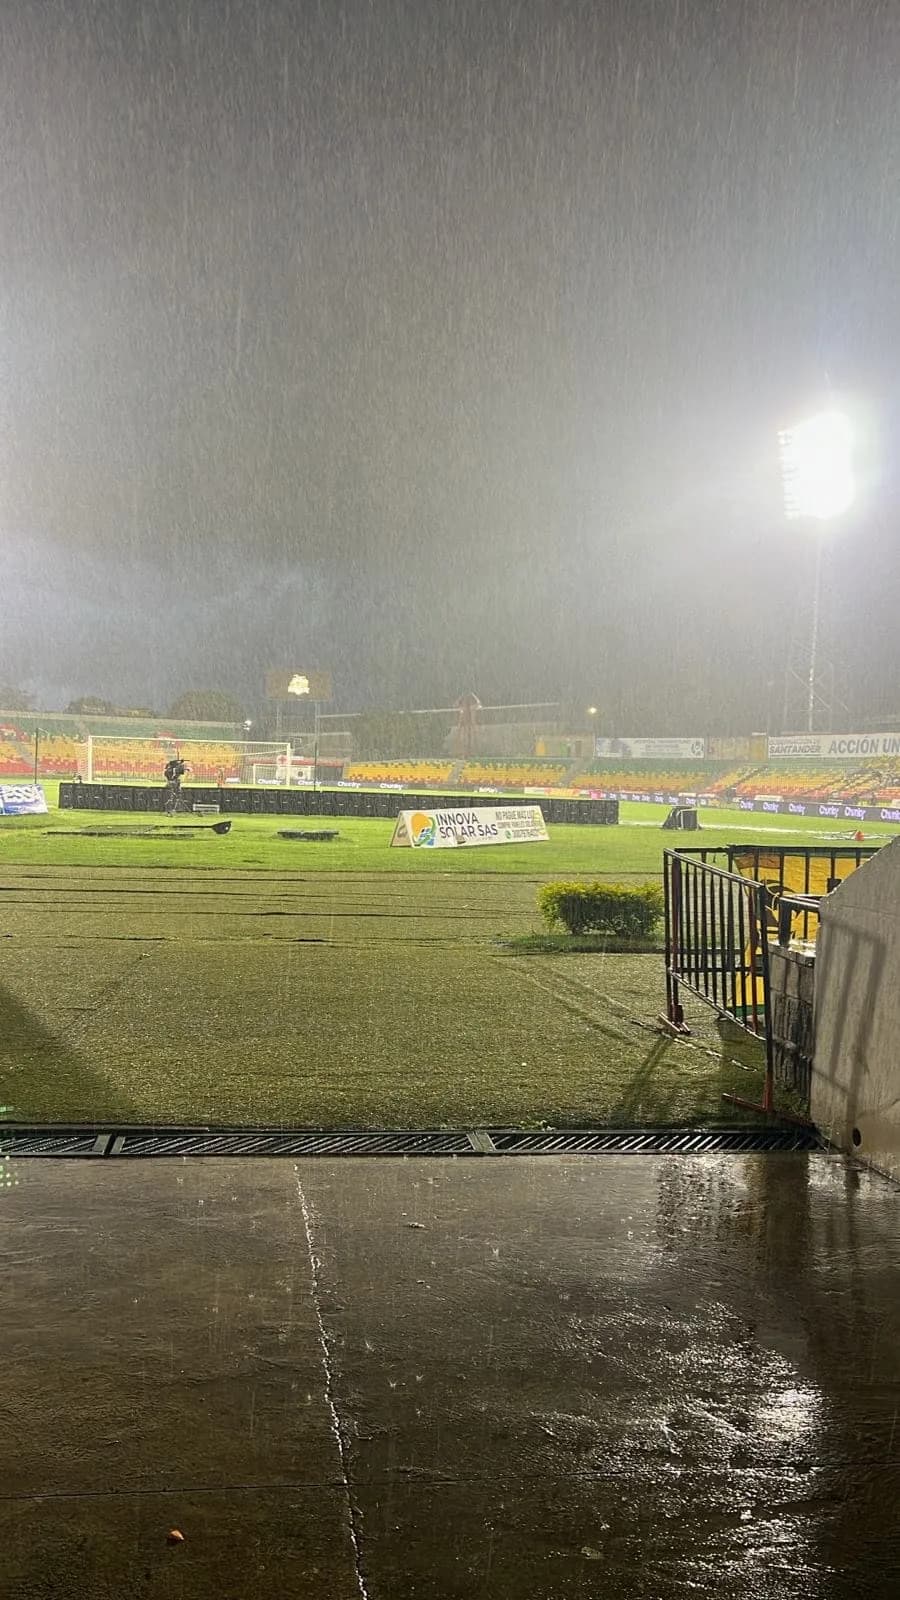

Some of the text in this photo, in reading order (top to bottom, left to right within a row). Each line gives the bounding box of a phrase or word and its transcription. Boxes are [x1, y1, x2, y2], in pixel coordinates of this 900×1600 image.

[769, 745, 821, 754] SANTANDER
[828, 736, 880, 754] ACCIÓN
[436, 812, 480, 825] INNOVA
[844, 806, 867, 820] Chunky
[477, 823, 498, 837] SAS
